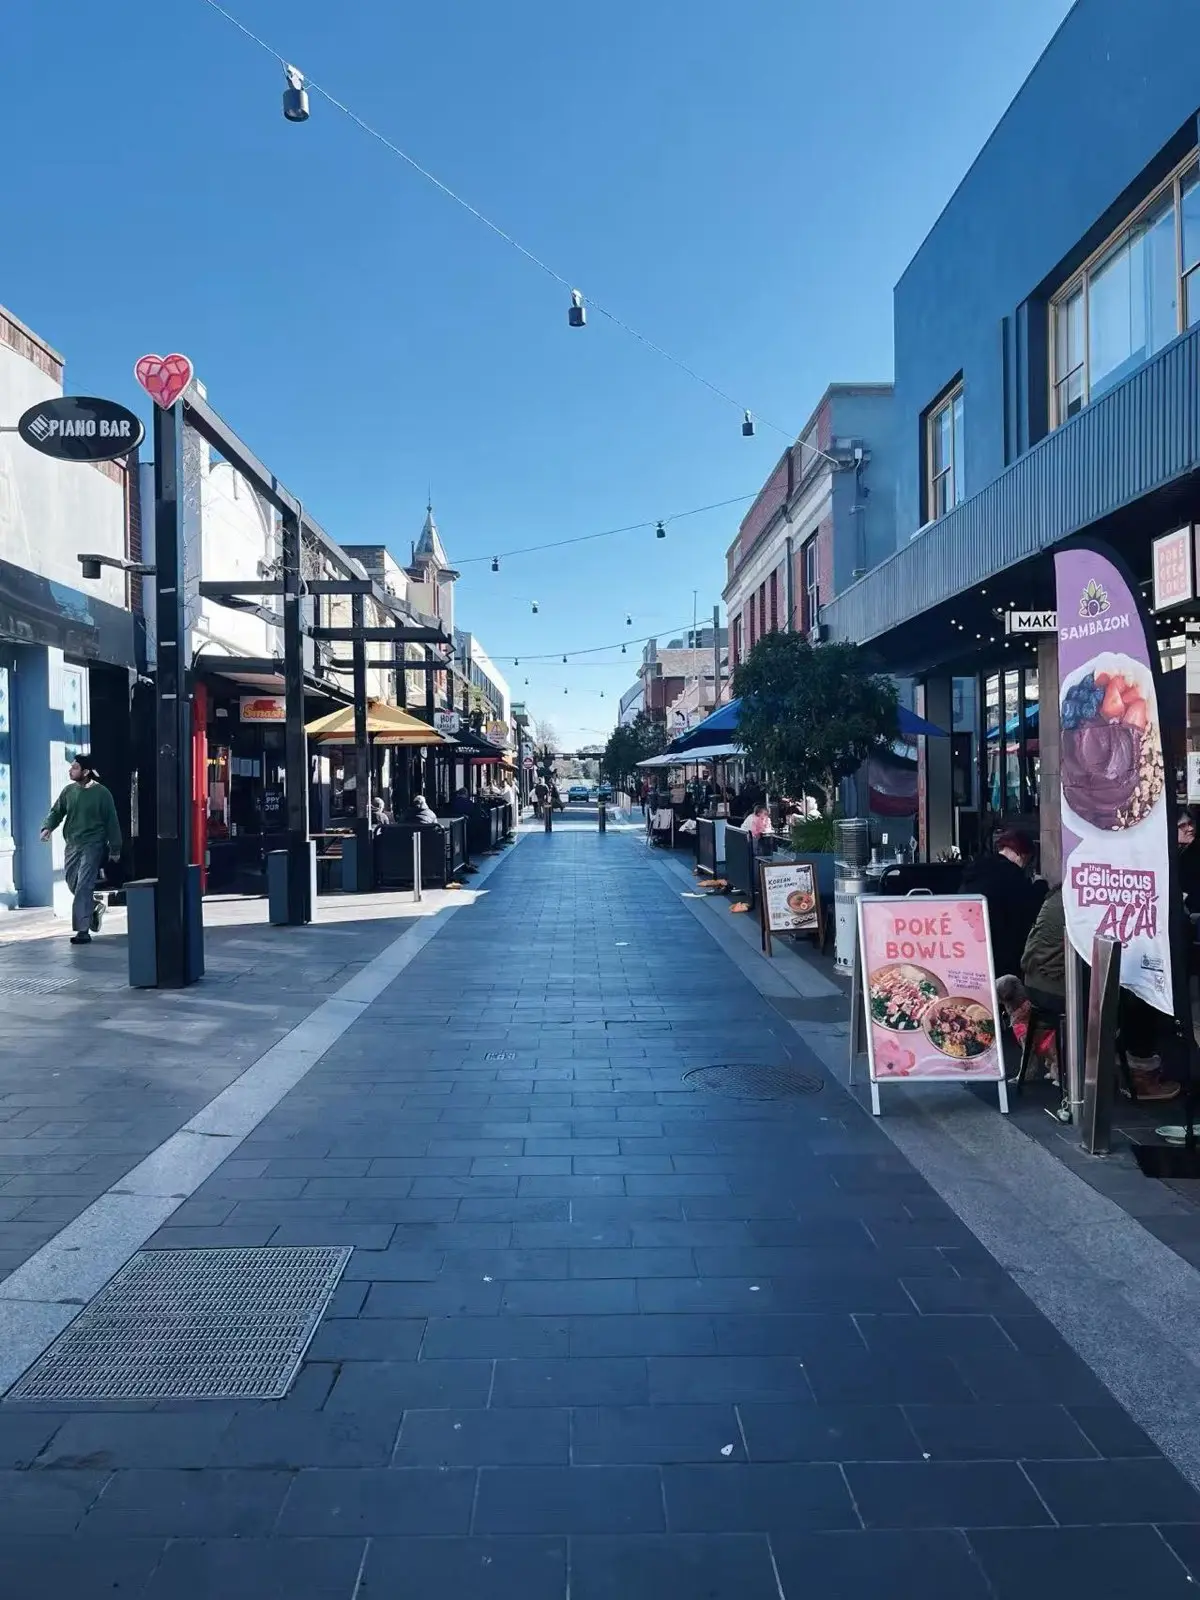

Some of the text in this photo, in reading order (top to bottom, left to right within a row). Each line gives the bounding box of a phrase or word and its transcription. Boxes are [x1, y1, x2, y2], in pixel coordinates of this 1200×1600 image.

[49, 419, 131, 437] PIANO BAR
[1018, 614, 1057, 628] MAKI
[1060, 614, 1130, 641] SAMBAZON
[1088, 864, 1101, 872] the
[768, 877, 791, 885] KOREAN
[1076, 867, 1152, 891] delicious
[1083, 886, 1147, 904] powers
[894, 911, 952, 936] POKÉ
[886, 941, 966, 960] BOWLS
